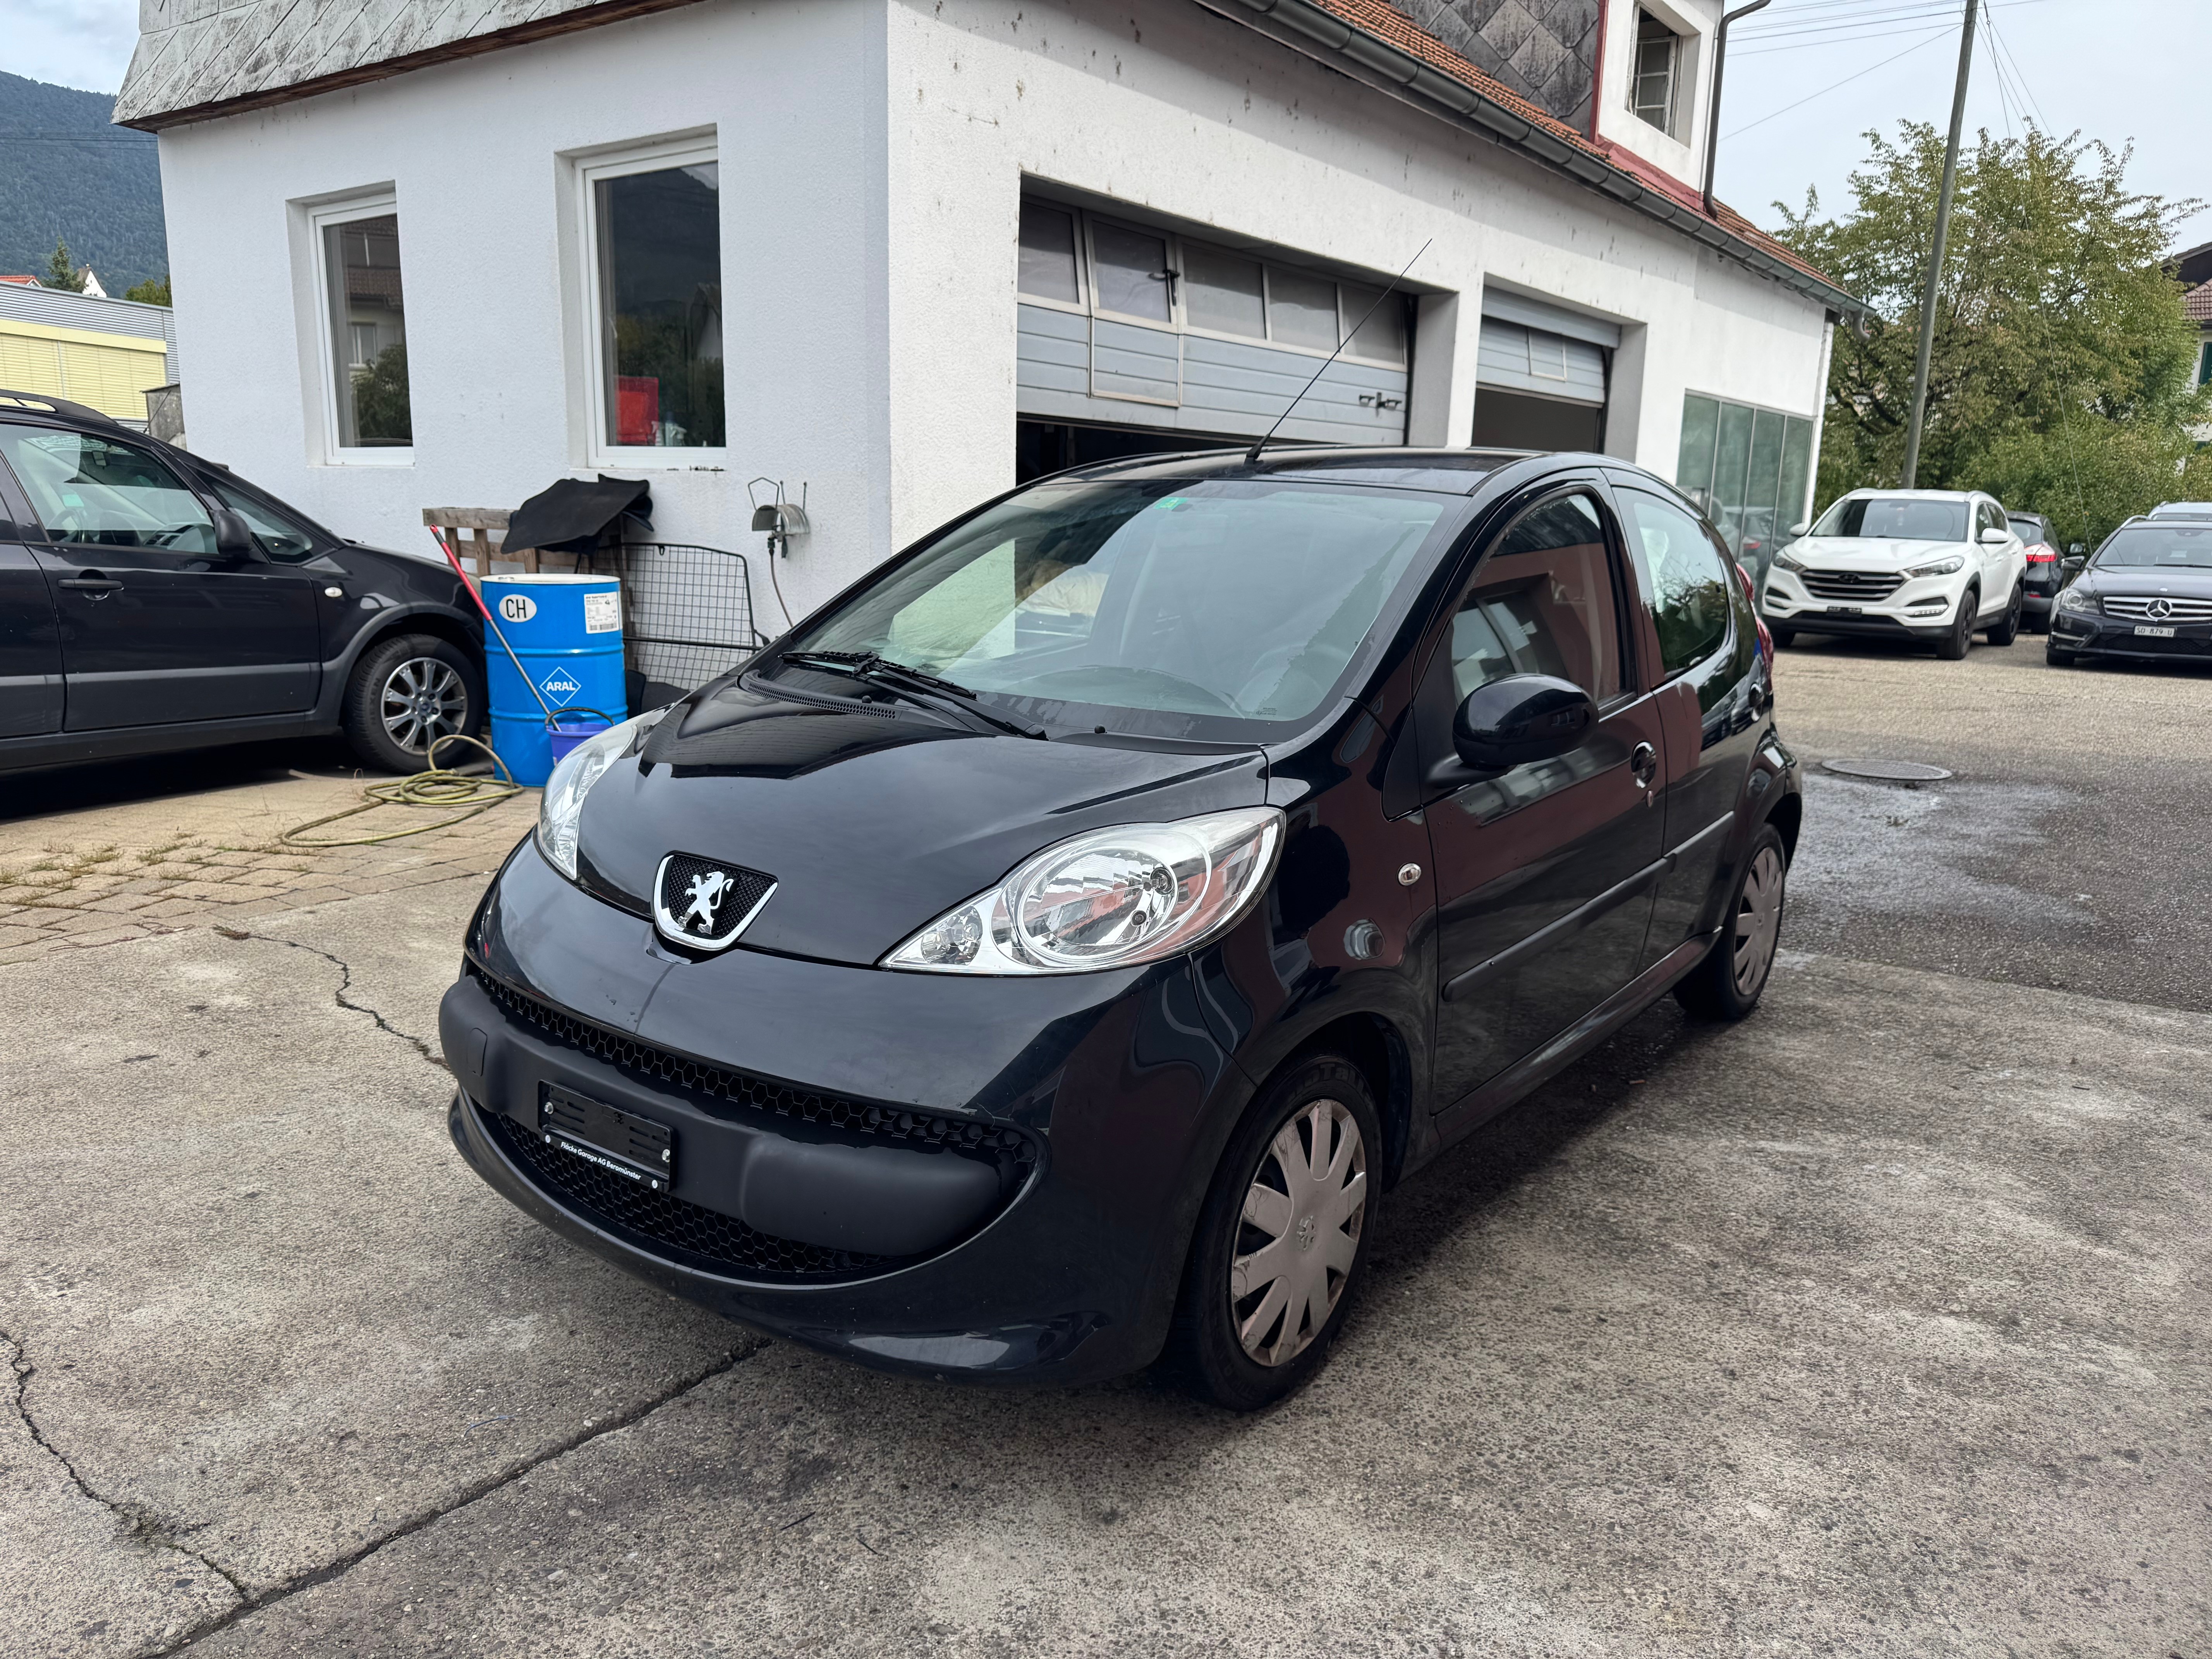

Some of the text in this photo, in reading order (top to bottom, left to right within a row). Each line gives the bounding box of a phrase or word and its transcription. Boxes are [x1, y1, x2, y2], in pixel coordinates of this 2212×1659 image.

[506, 599, 526, 618] CH
[546, 681, 576, 691] ARAL
[561, 1142, 641, 1180] Fläcke Garage AG Beromünster
